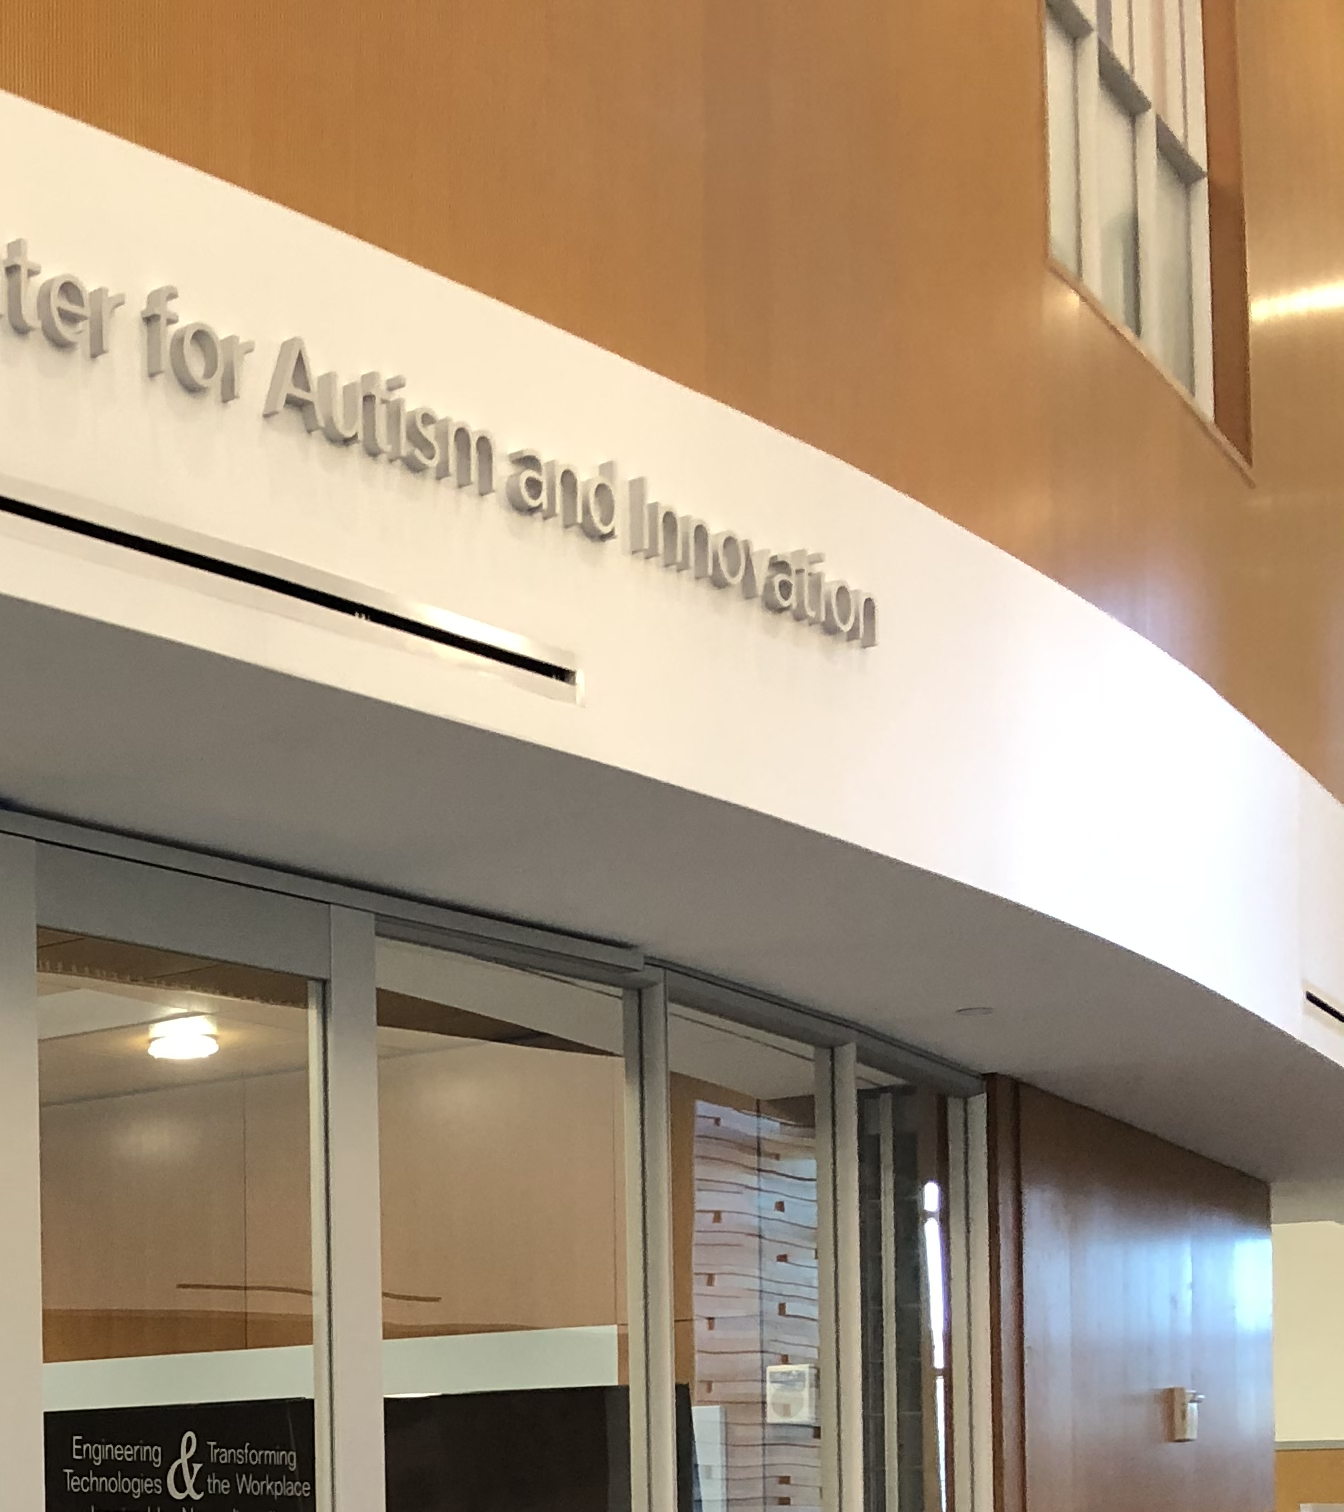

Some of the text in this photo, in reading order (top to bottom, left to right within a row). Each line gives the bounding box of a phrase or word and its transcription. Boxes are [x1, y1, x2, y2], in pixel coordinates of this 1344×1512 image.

[140, 284, 255, 403] for
[263, 335, 496, 496] Autism
[507, 461, 618, 541] and
[628, 476, 878, 648] Innovation
[72, 1435, 162, 1467] Engineering
[206, 1441, 297, 1471] Transforming
[63, 1468, 310, 1500] Technologies the Workplace
